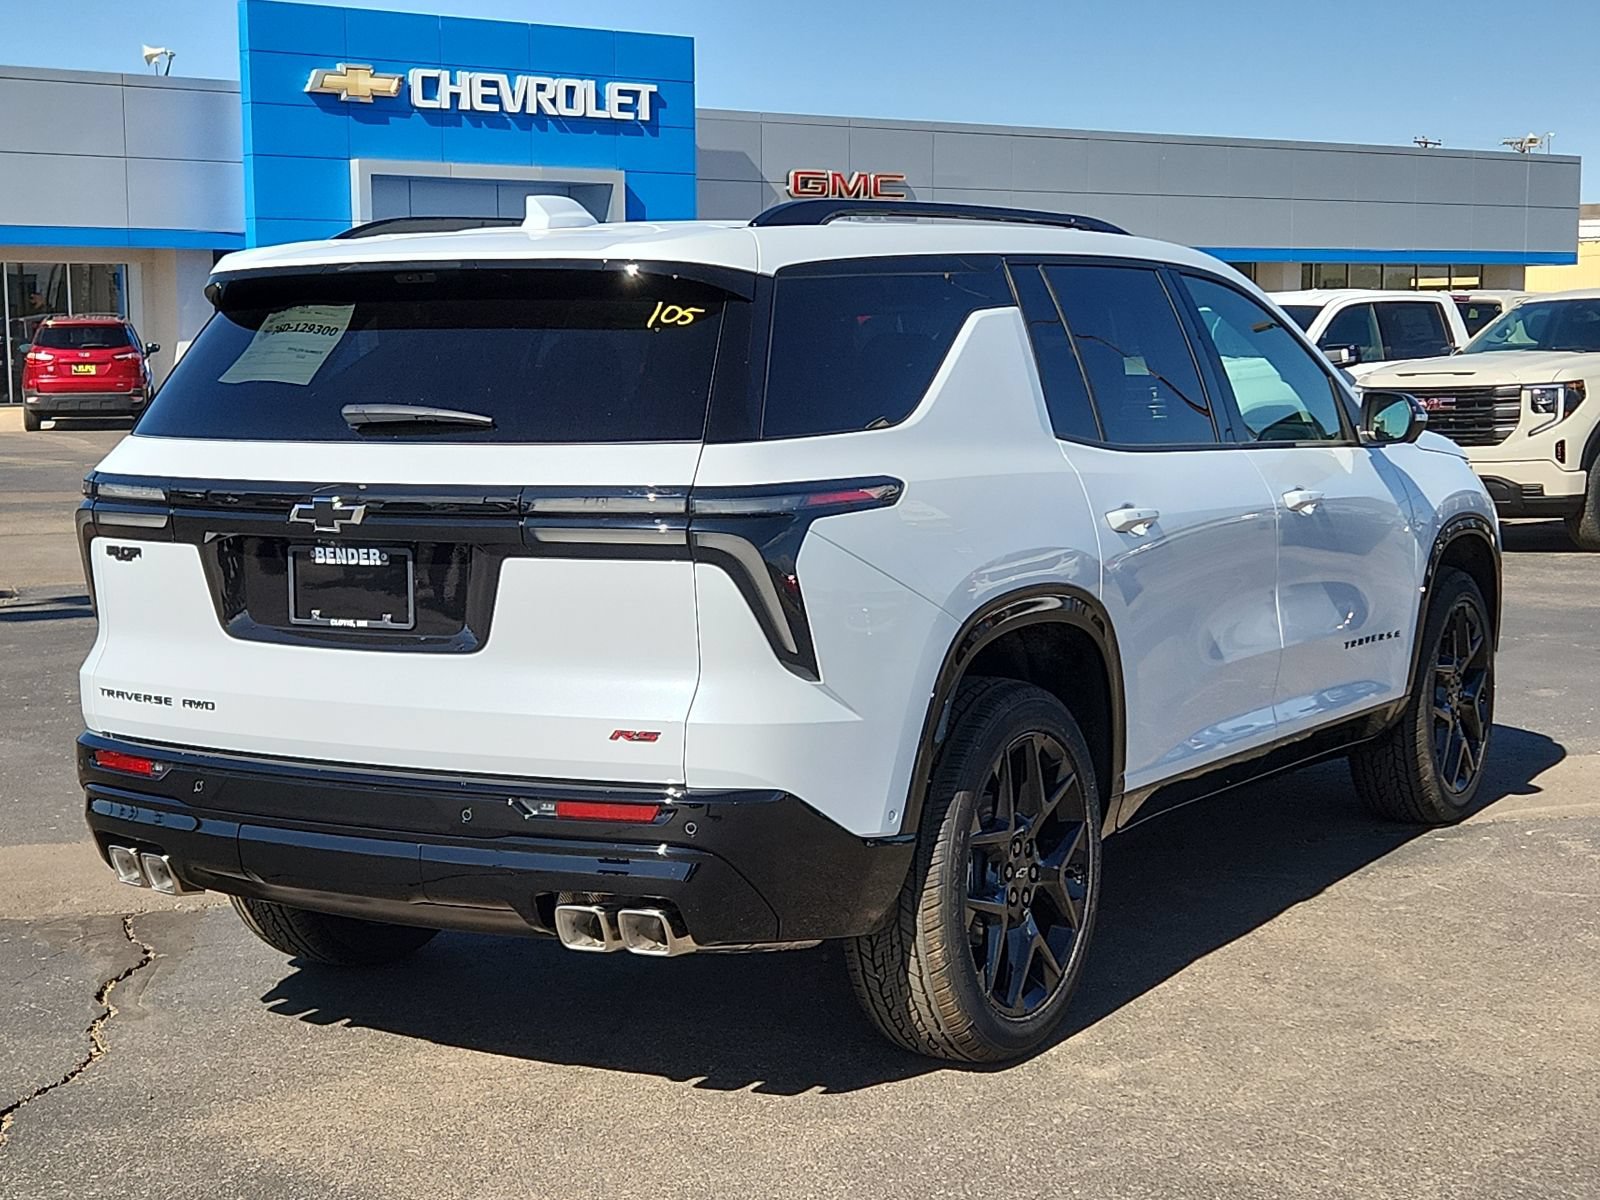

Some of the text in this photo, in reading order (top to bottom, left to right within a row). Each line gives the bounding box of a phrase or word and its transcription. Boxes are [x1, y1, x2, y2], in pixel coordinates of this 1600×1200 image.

[408, 67, 658, 121] CHEVROLET
[786, 169, 906, 199] GMC
[646, 301, 706, 328] 105
[314, 547, 382, 565] BENDER
[1343, 629, 1401, 650] TRAVERSE
[99, 687, 216, 711] TRAVERSE AWD
[608, 729, 662, 743] RS
